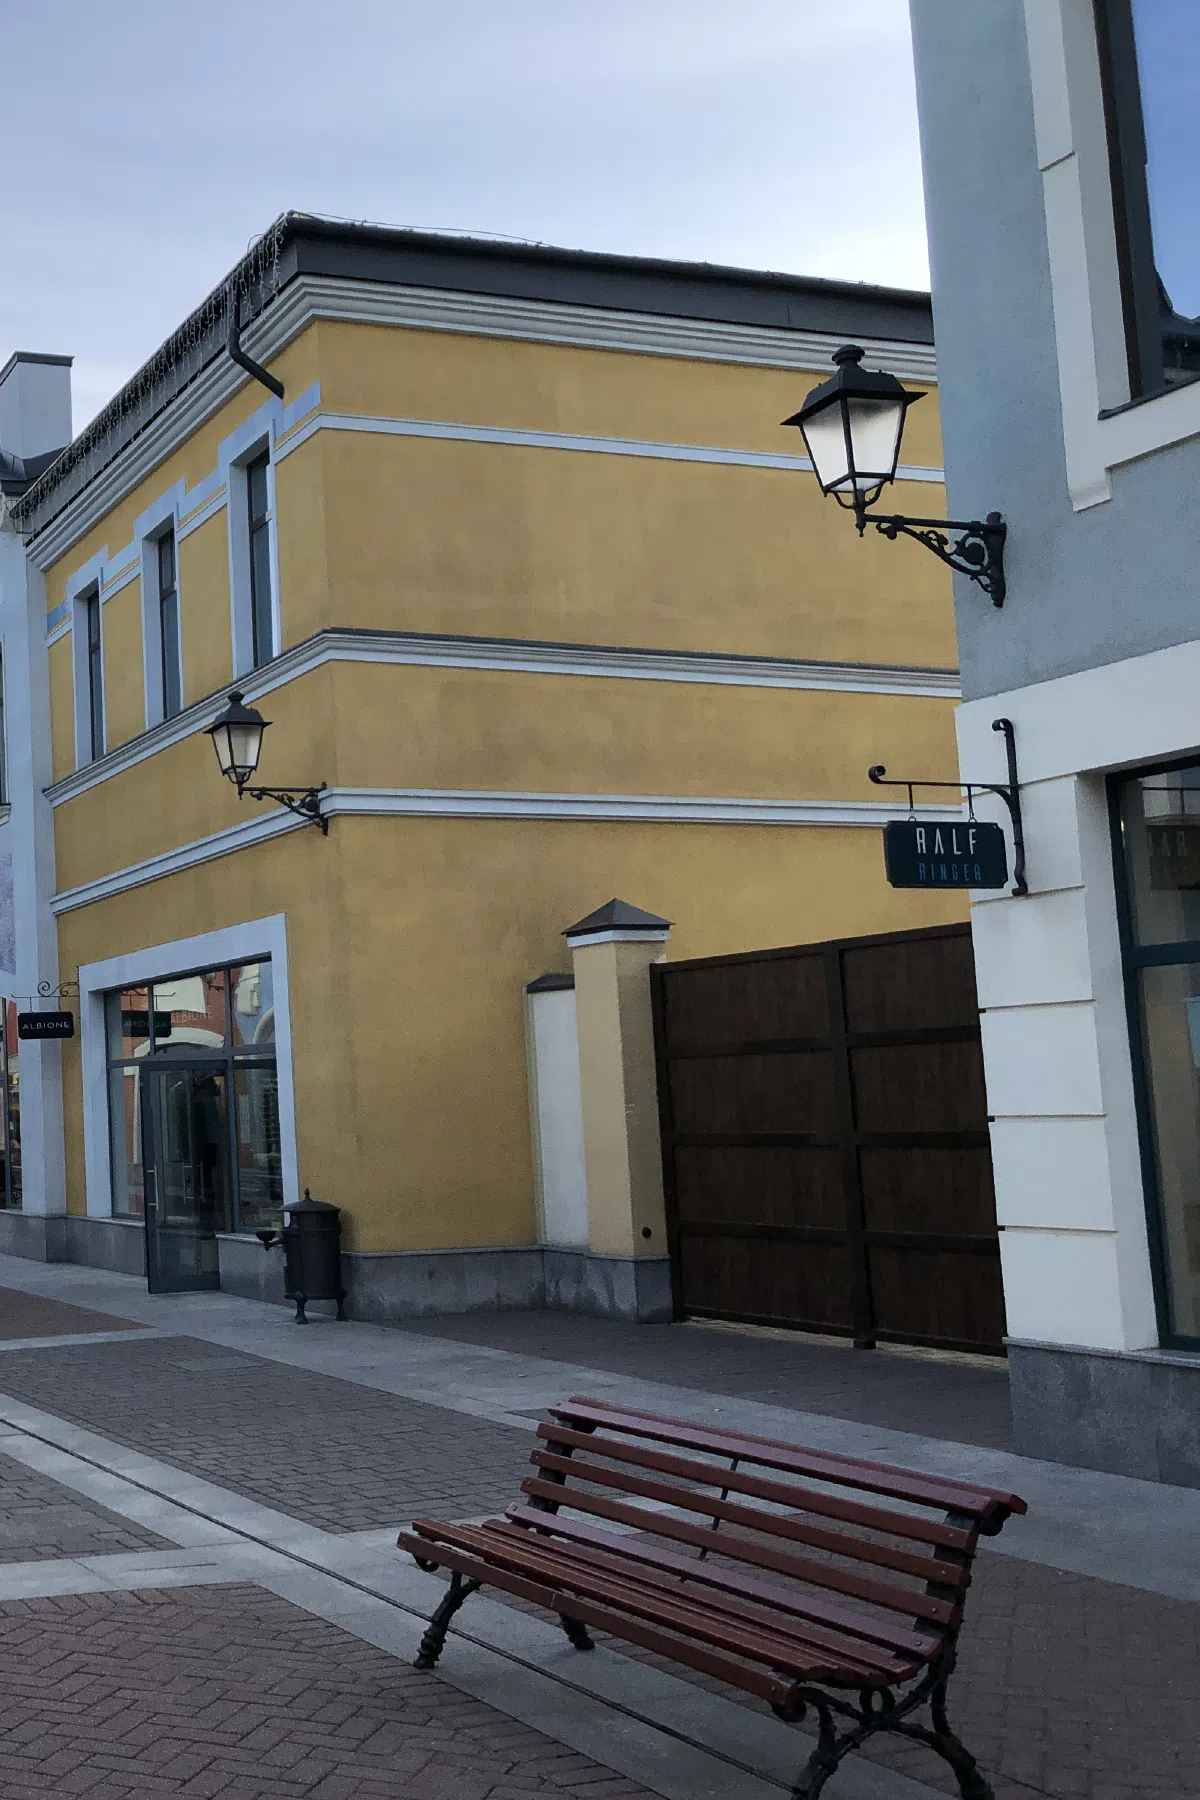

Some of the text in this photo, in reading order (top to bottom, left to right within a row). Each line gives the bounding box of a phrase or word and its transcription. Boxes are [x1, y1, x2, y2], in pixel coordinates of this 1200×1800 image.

[916, 827, 977, 855] RALF
[919, 863, 981, 881] RINGER
[22, 1021, 70, 1030] ALBIONE
